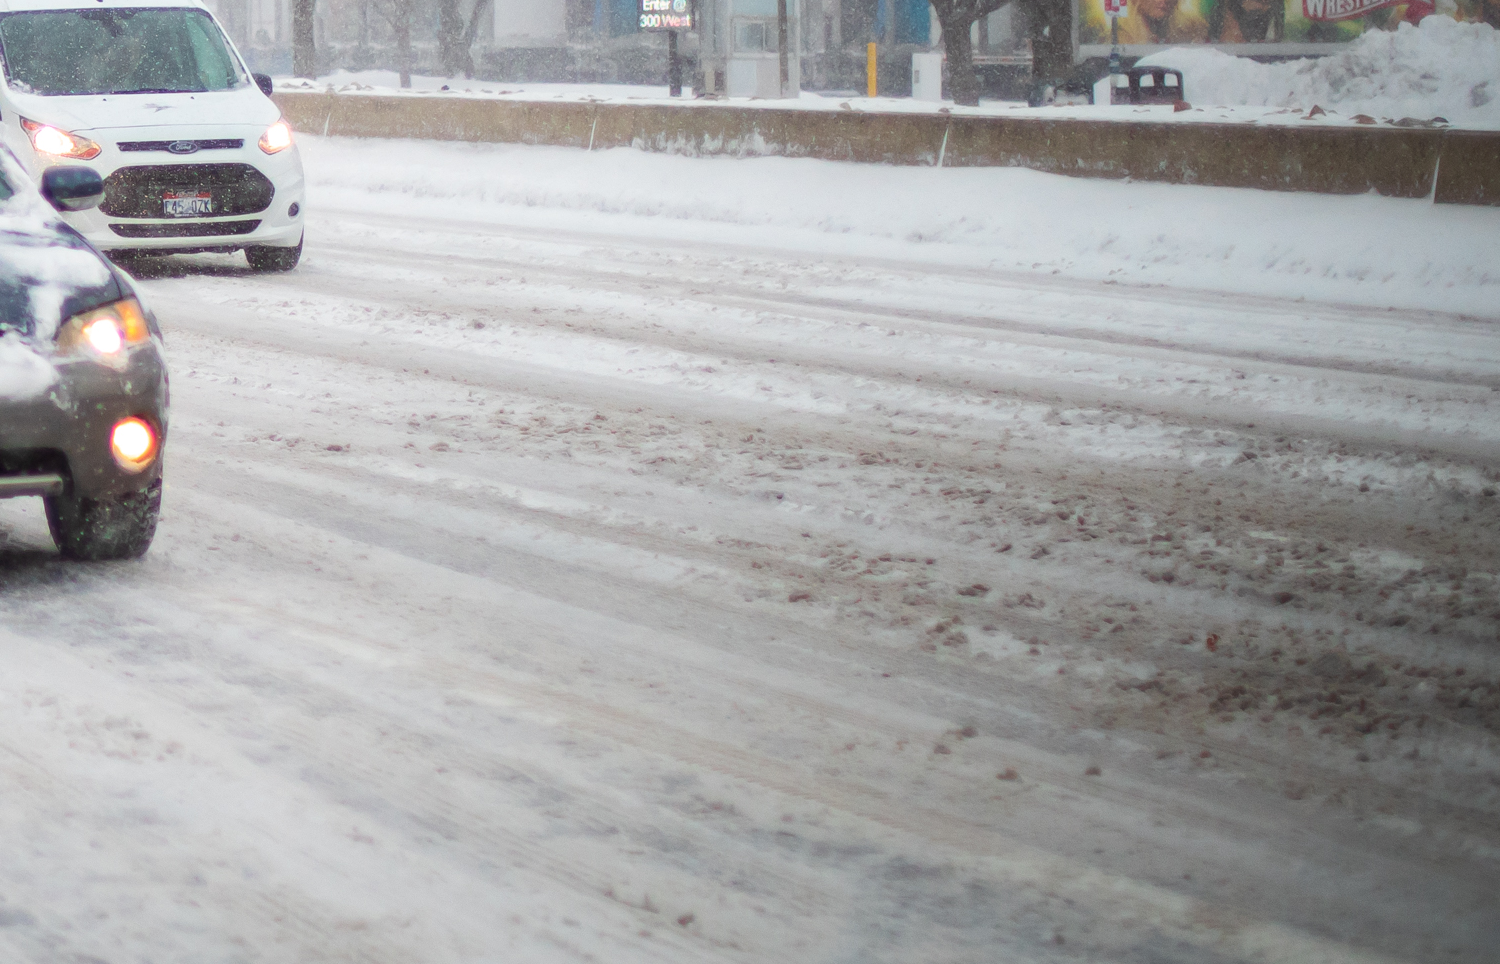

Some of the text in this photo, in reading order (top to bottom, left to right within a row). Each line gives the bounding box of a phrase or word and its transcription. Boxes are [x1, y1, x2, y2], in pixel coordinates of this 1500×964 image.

[640, 13, 691, 27] 300 West
[175, 143, 192, 151] Ford
